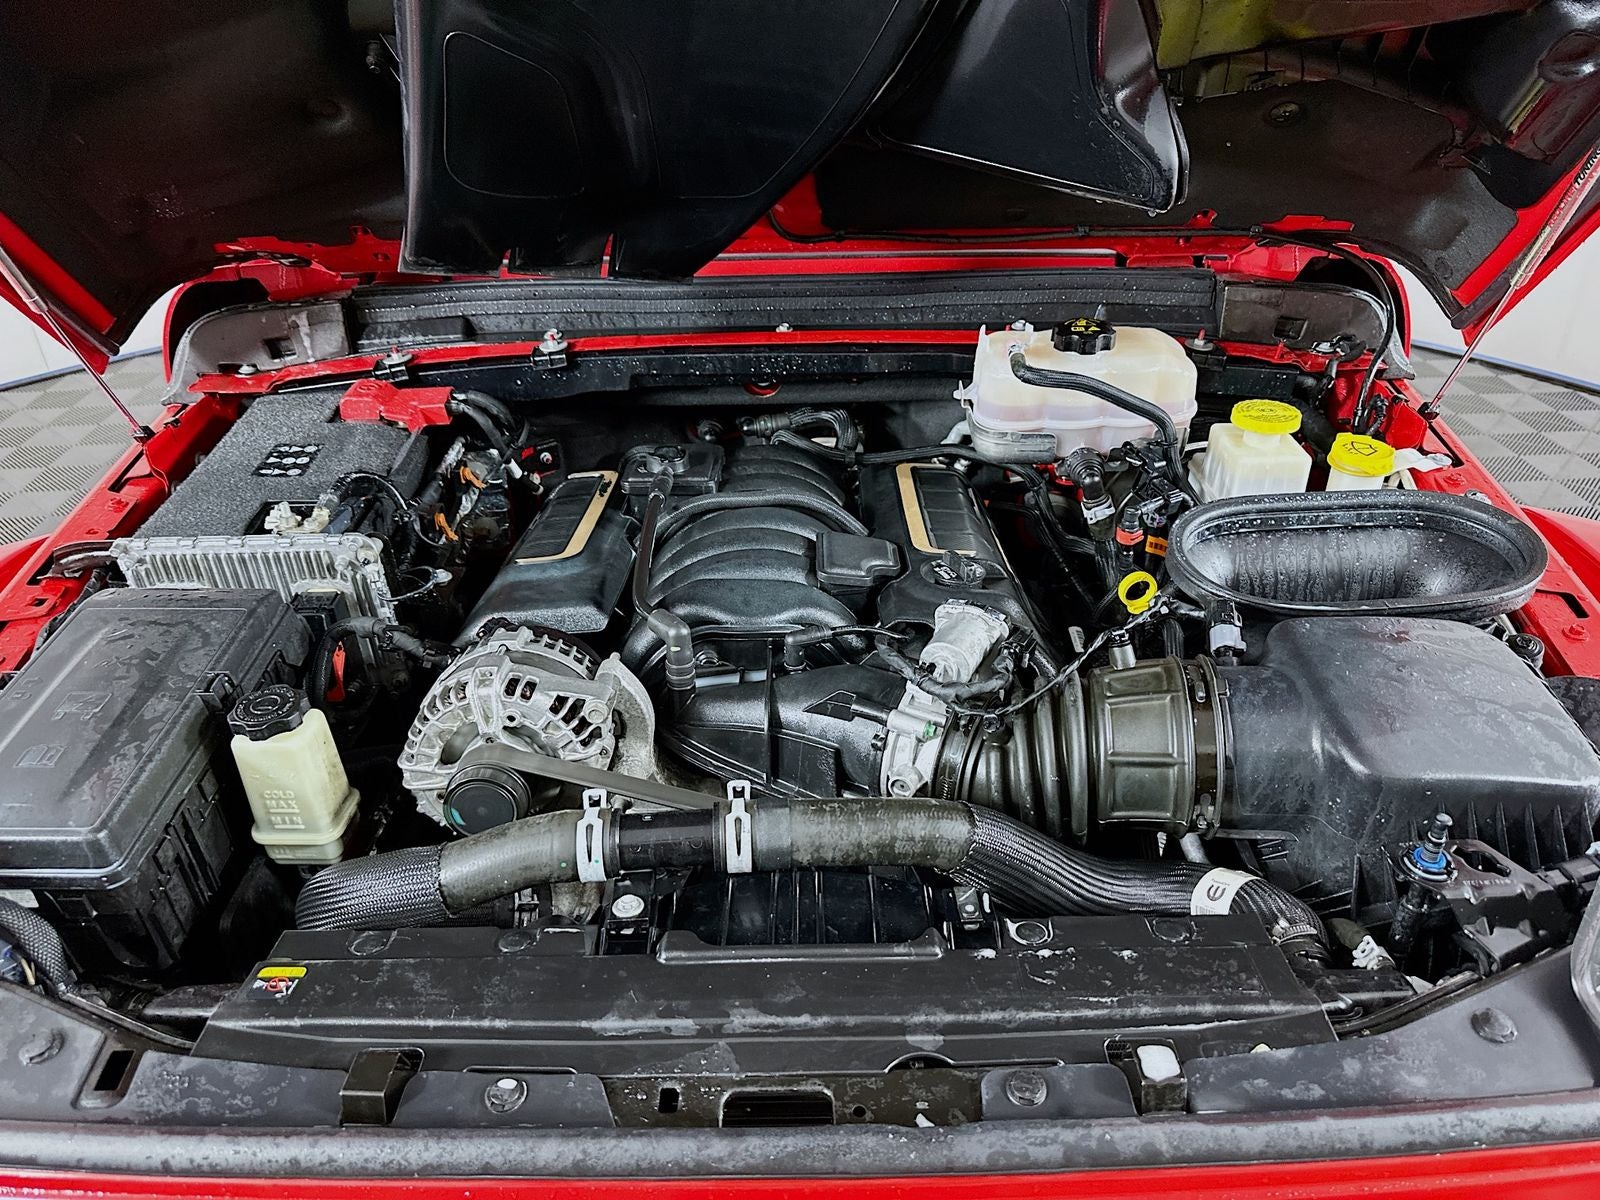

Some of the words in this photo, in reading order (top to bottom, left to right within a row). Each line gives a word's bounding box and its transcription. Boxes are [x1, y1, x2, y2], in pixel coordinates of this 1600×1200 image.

[264, 790, 295, 799] COLD
[266, 800, 298, 809] MAX
[271, 816, 302, 825] MIN
